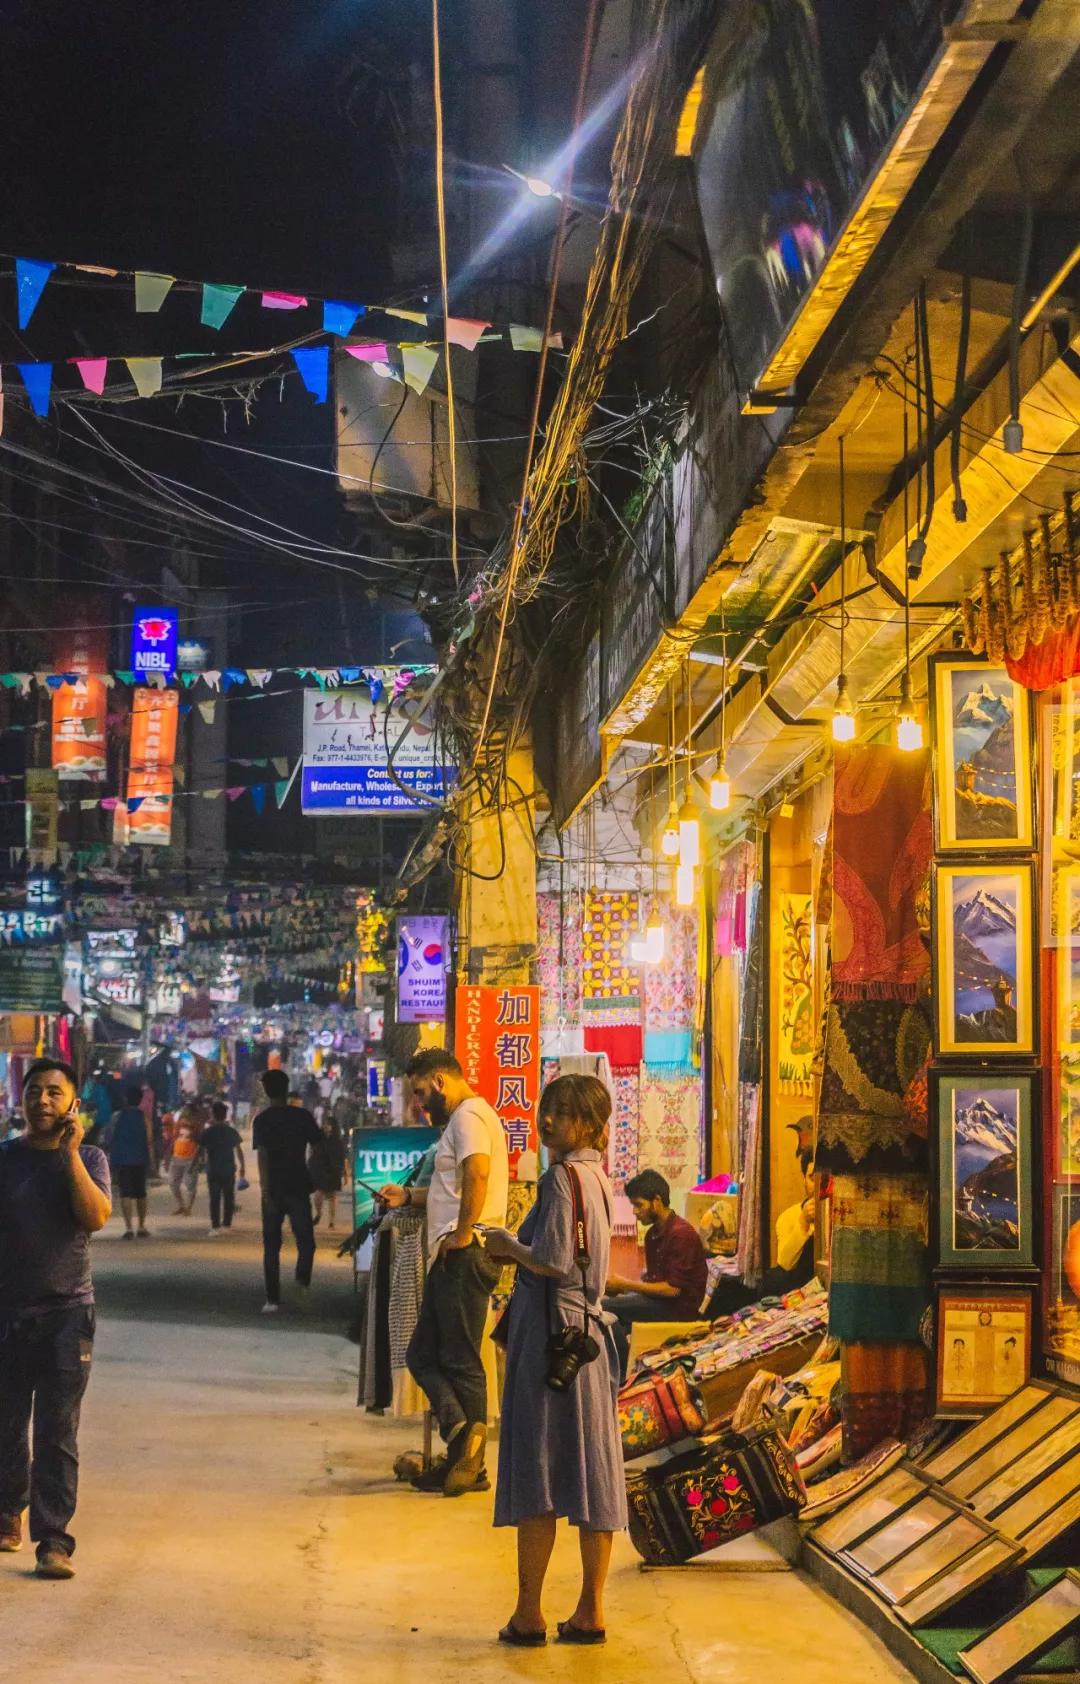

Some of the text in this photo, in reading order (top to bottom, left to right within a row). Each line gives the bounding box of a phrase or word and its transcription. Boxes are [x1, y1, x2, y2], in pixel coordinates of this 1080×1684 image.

[136, 651, 171, 668] NIBL
[367, 769, 401, 779] Contct
[403, 770, 414, 779] us
[311, 781, 364, 792] Manufacture,
[346, 796, 356, 805] all
[358, 796, 381, 806] kinds
[382, 796, 391, 806] of
[467, 990, 481, 1085] HANDICRAFTS
[496, 990, 532, 1153] 加都风情
[358, 1150, 423, 1173] TUBO
